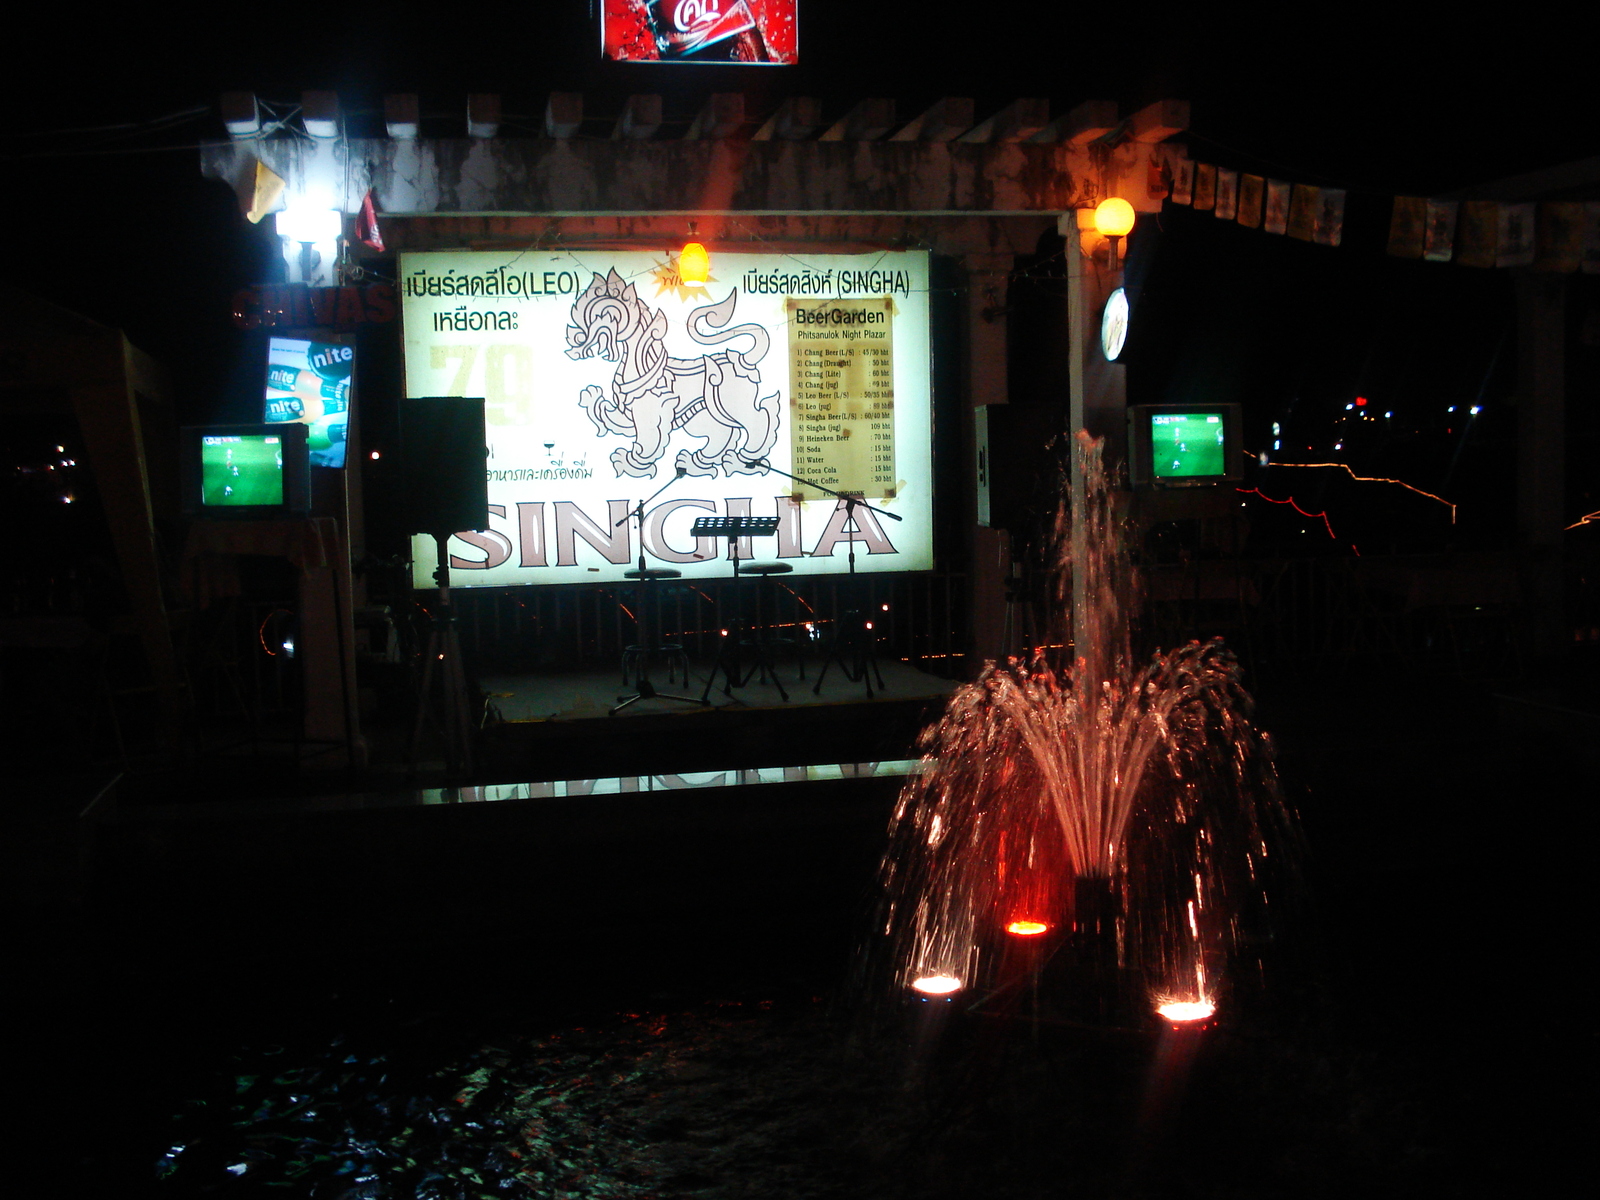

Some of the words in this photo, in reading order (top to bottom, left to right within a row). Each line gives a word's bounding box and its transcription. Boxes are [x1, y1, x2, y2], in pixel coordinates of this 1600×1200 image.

[837, 270, 909, 299] (SINGHA)
[433, 306, 518, 332] เหยือกละ
[798, 330, 839, 339] Phitsanulok
[842, 330, 861, 341] Night
[863, 330, 886, 339] Plazar
[313, 346, 353, 368] nite
[804, 349, 823, 357] Chang
[271, 370, 295, 384] nite
[804, 371, 823, 379] Chang
[825, 370, 841, 378] (Lite)
[805, 382, 823, 390] Chang
[826, 381, 838, 390] (jug)
[834, 391, 849, 399] (L/S)
[270, 400, 300, 414] nite
[819, 403, 831, 411] (jug)
[805, 414, 826, 422] Singha
[806, 424, 826, 433] Singha
[828, 424, 841, 432] (jug)
[450, 497, 899, 569] SINGHA
